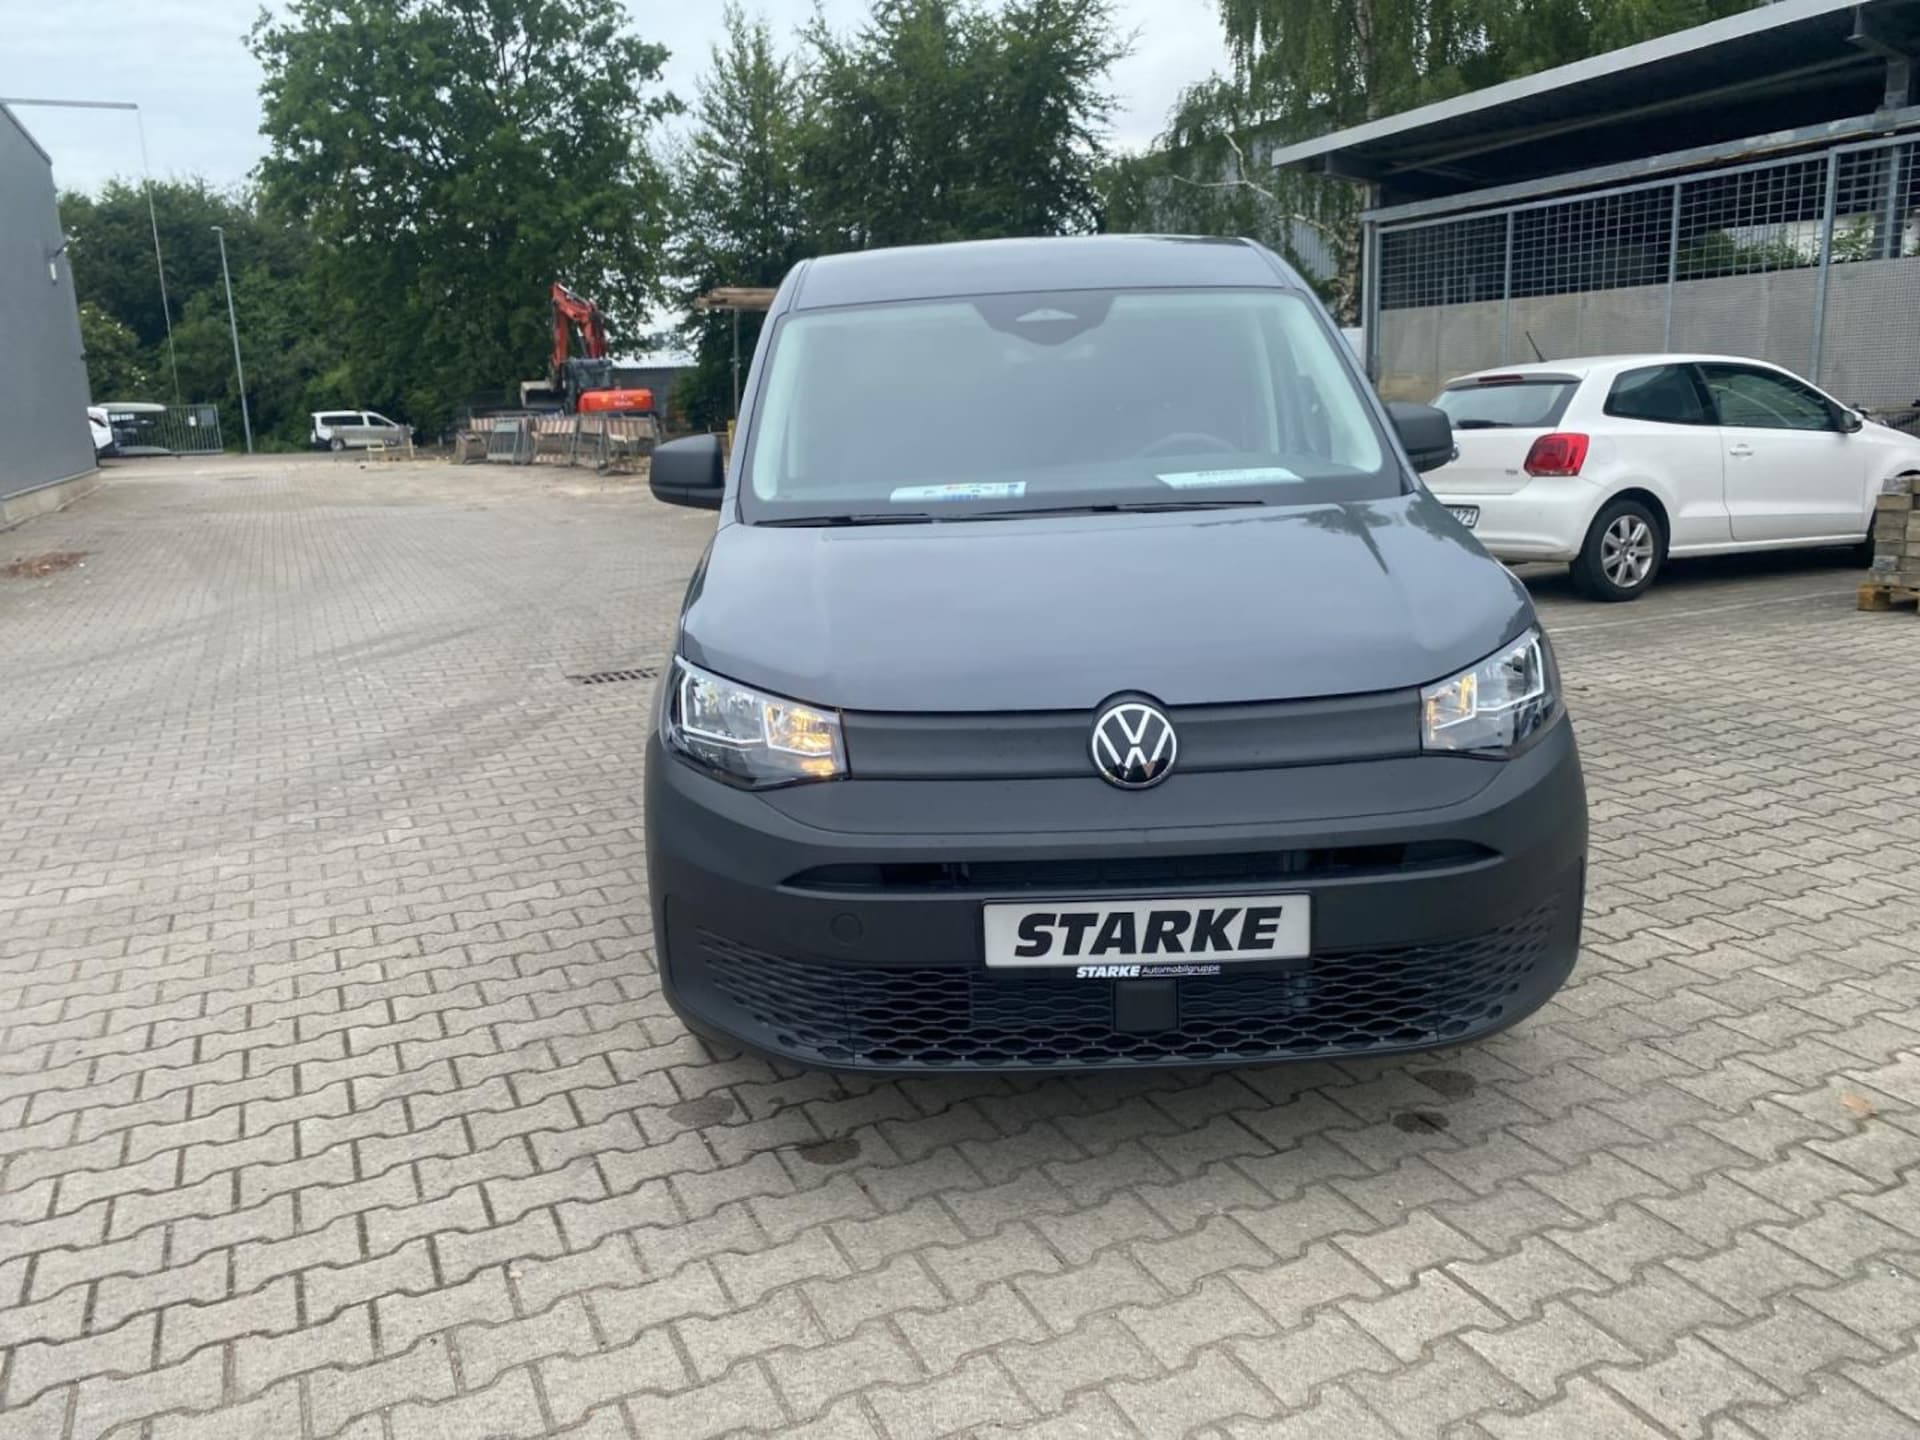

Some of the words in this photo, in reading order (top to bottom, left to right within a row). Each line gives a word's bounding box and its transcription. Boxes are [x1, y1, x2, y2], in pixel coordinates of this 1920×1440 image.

[1014, 906, 1283, 958] STARKE
[1076, 965, 1141, 979] STARKE
[1141, 964, 1221, 976] Automobilgruppe
